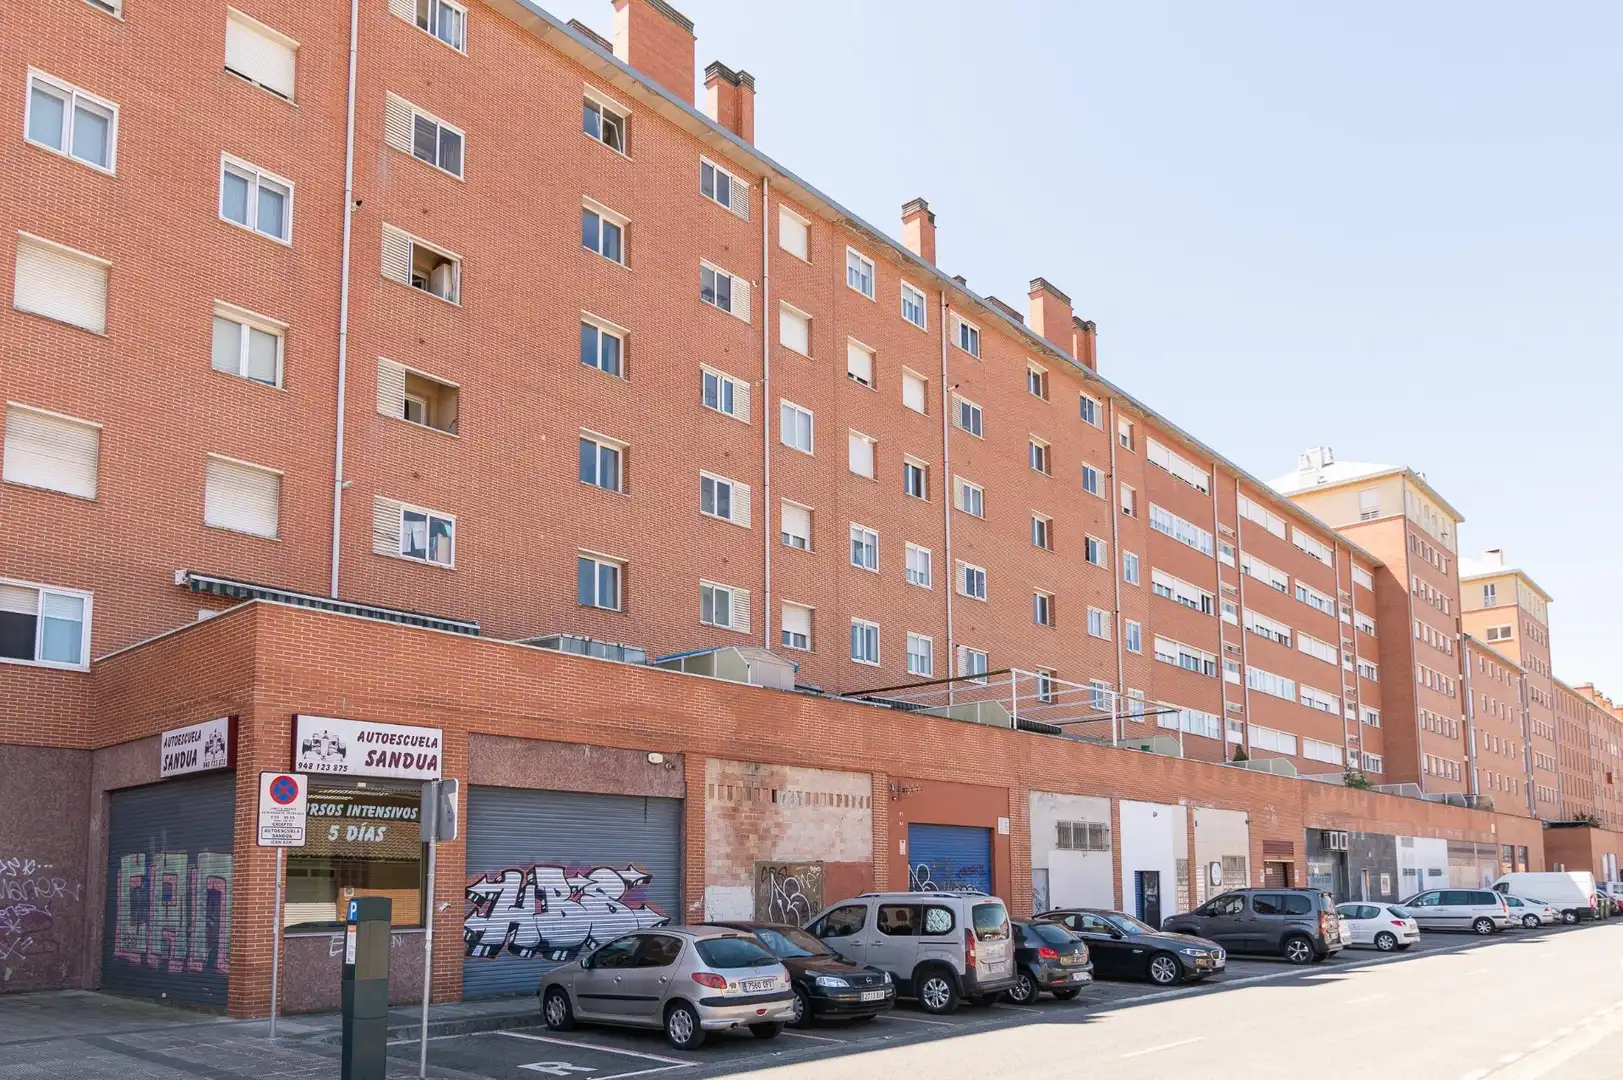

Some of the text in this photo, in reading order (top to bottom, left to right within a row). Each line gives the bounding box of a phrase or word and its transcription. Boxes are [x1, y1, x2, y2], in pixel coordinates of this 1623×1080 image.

[164, 730, 202, 748] AUTOESCUELA
[357, 731, 438, 748] AUTOESCUELA
[163, 749, 197, 771] SANDUA
[298, 762, 313, 770] 948
[316, 763, 331, 771] 123
[365, 750, 437, 771] SANDUA
[346, 804, 418, 819] INTENSIVOS
[327, 822, 387, 842] 5 DÍAS
[350, 901, 358, 919] P
